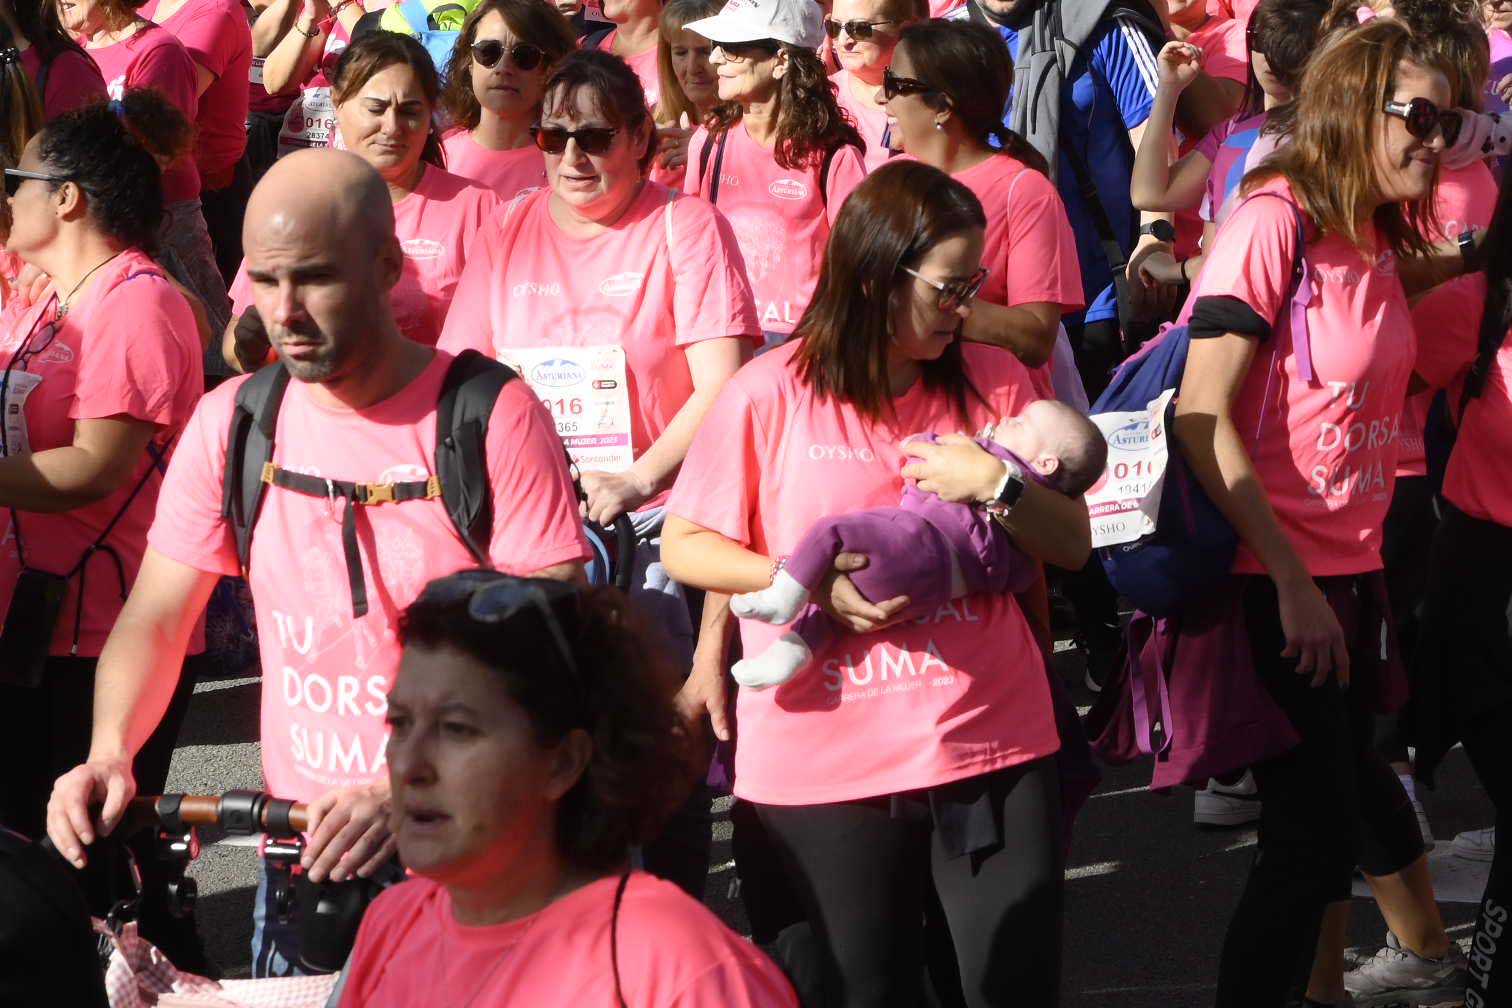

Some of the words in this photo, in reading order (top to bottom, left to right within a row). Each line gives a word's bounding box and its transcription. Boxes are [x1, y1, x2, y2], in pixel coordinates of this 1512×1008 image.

[306, 117, 332, 131] 016
[1327, 380, 1370, 409] TU
[1113, 432, 1150, 445] ASTURI
[1316, 418, 1400, 452] DORSA
[809, 444, 874, 463] OYSHO
[1306, 463, 1385, 497] SUMA
[273, 611, 313, 656] TU
[819, 641, 949, 693] SUMA
[283, 668, 389, 718] DORS
[1471, 897, 1509, 990] SPORT
